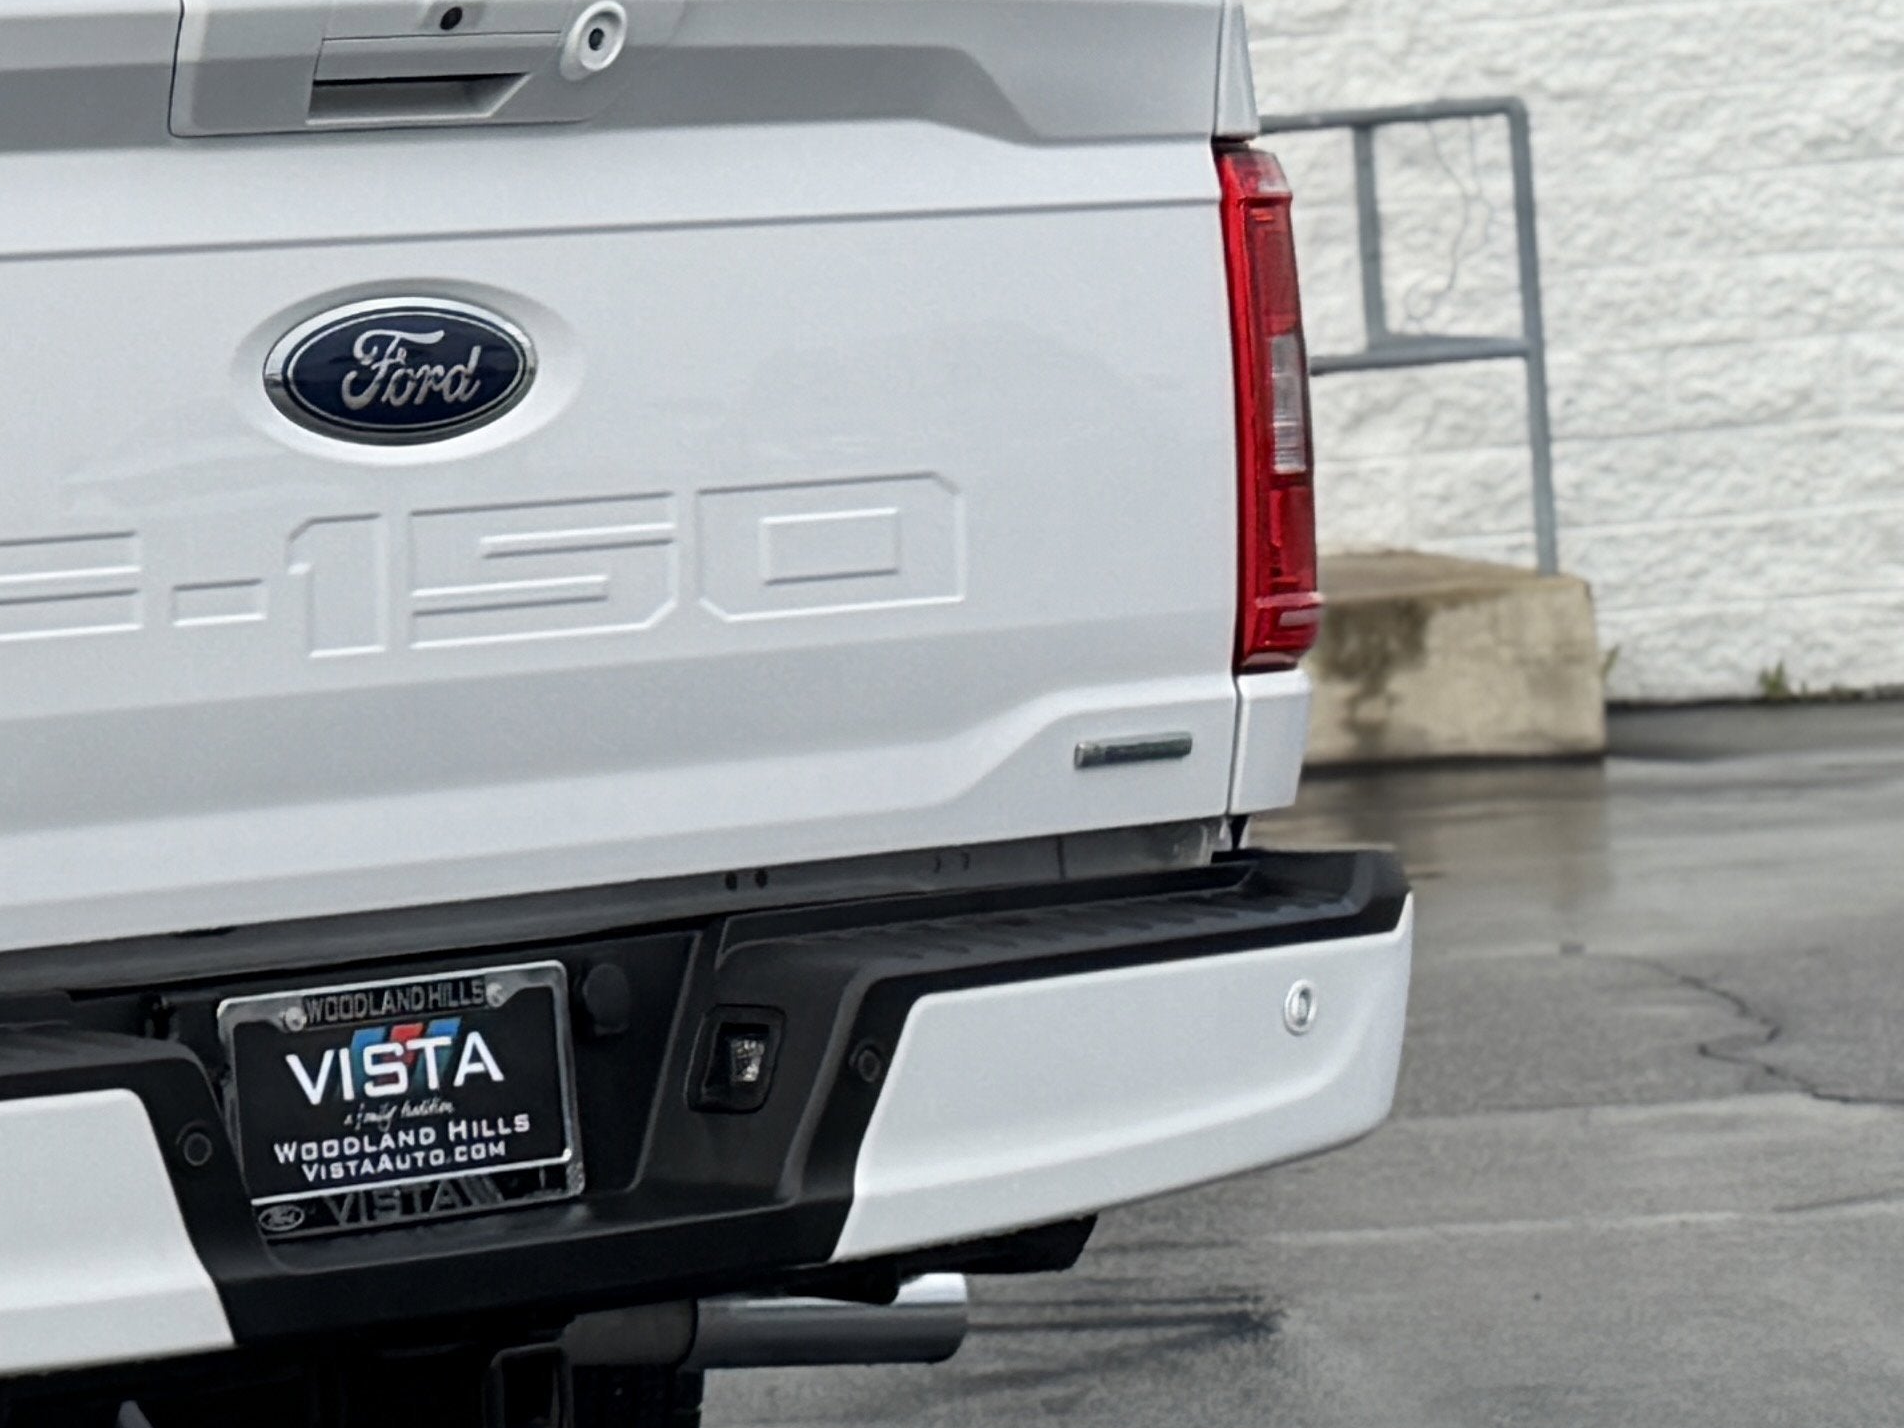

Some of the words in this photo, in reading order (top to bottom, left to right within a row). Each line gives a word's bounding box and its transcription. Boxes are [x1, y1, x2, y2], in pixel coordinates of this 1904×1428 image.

[341, 328, 481, 411] Ford
[306, 987, 425, 1022] WOODLAND
[428, 978, 486, 1009] HILLS
[285, 1030, 505, 1106] VISTA
[273, 1126, 437, 1164] WOODLAND
[448, 1113, 531, 1142] HILLS
[323, 1177, 465, 1226] VISTA
